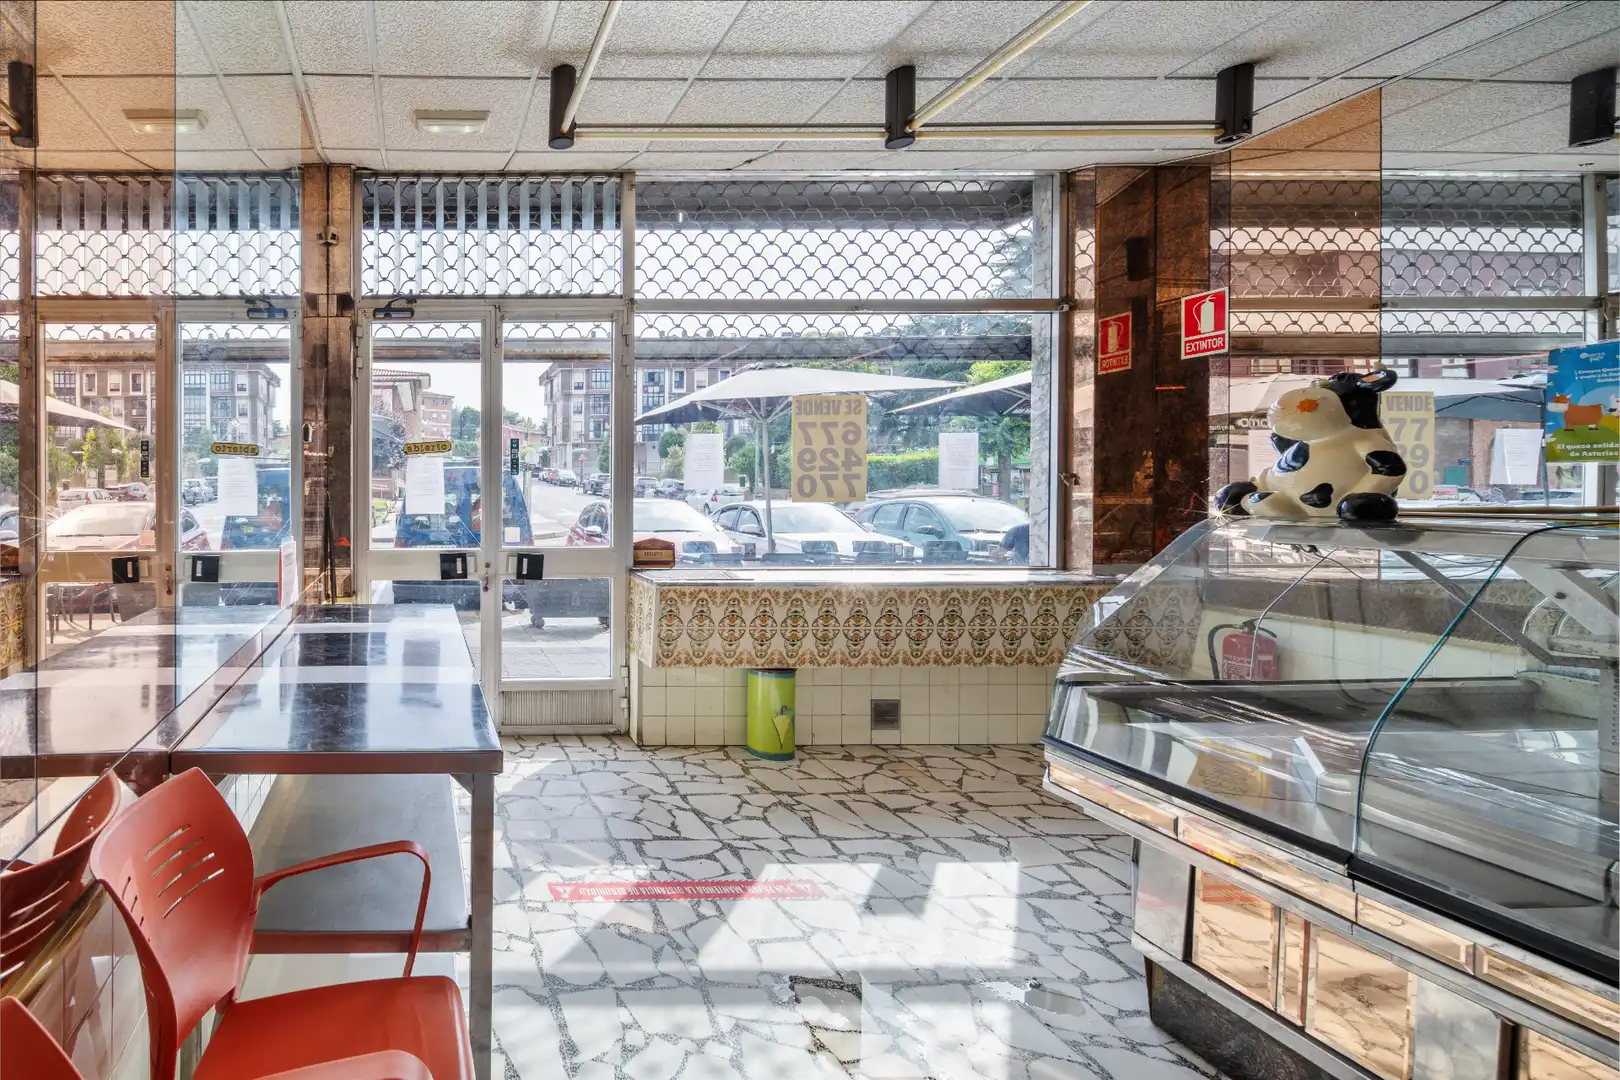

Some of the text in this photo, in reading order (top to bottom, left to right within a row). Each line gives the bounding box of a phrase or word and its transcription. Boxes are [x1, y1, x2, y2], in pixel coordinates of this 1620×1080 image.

[1185, 337, 1224, 353] EXTINTOR
[1386, 395, 1432, 412] VENDE
[1388, 418, 1429, 442] 77
[406, 442, 448, 453] abierto
[1566, 443, 1592, 451] queso
[640, 886, 686, 896] DISTANCIA
